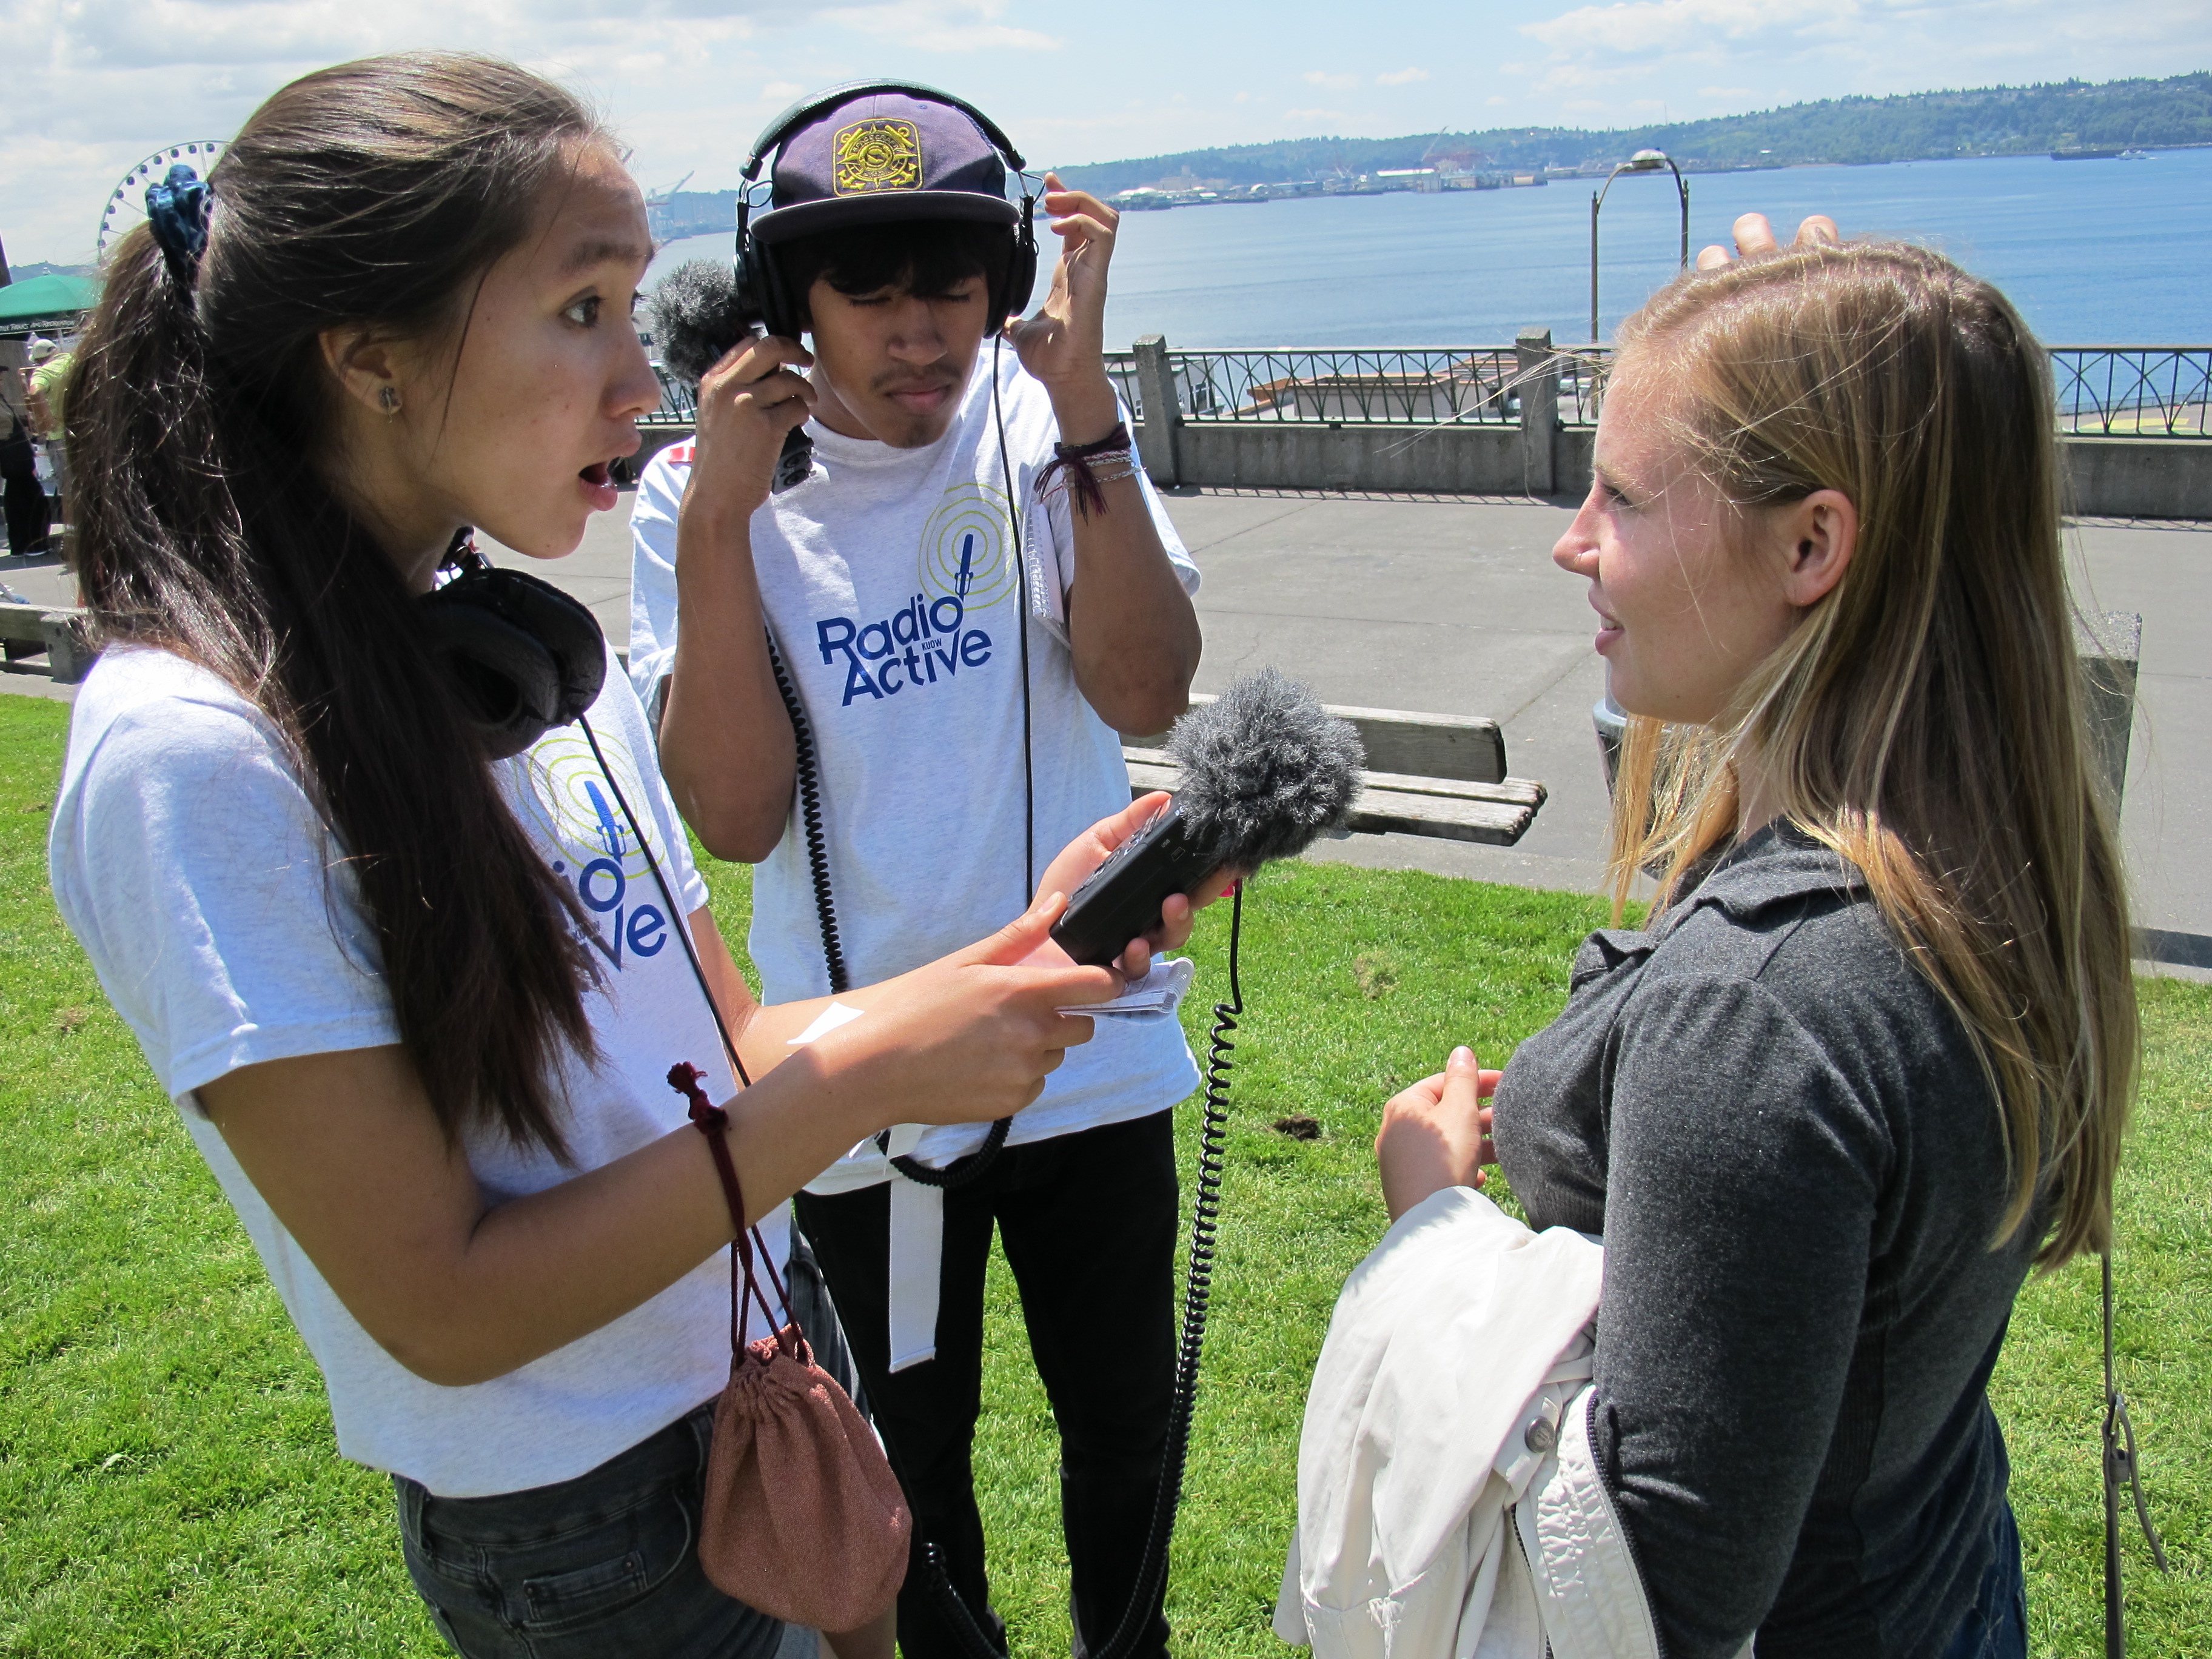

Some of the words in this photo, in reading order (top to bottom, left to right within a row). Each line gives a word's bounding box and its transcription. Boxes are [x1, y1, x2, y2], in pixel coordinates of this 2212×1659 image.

[816, 593, 964, 665] Radio
[922, 638, 942, 651] KUOW
[842, 628, 993, 707] Active
[1161, 839, 1171, 848] USB
